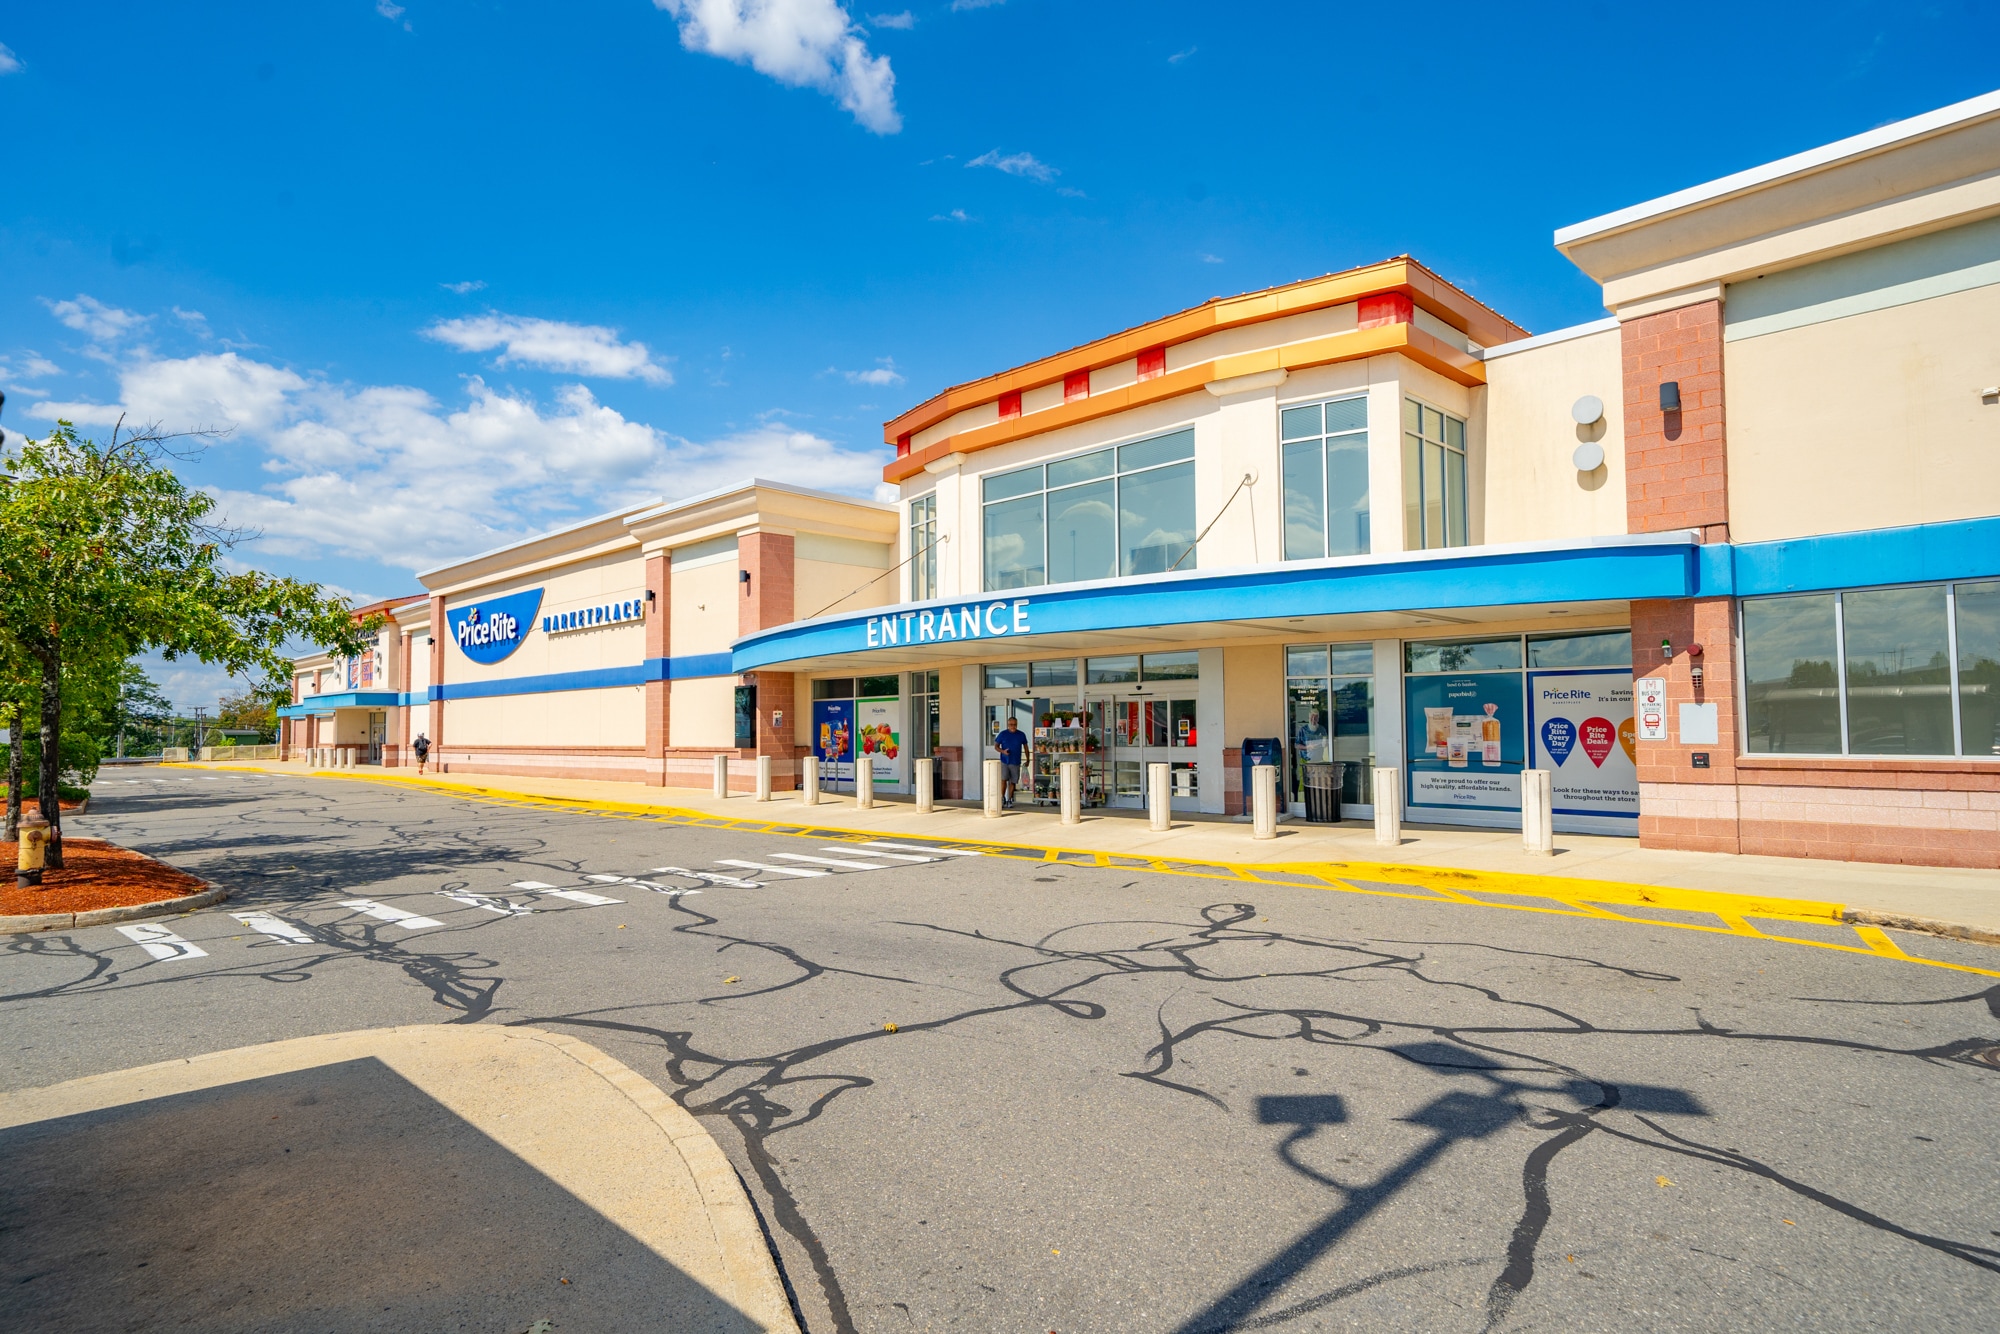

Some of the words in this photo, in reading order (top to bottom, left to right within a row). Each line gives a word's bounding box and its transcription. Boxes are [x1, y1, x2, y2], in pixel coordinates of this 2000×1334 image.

[458, 618, 489, 647] Price
[490, 612, 516, 642] Rite
[543, 599, 641, 632] MARKETPLACE
[867, 599, 1031, 648] ENTRANCE
[1543, 690, 1569, 699] Price
[1570, 690, 1591, 699] Rite
